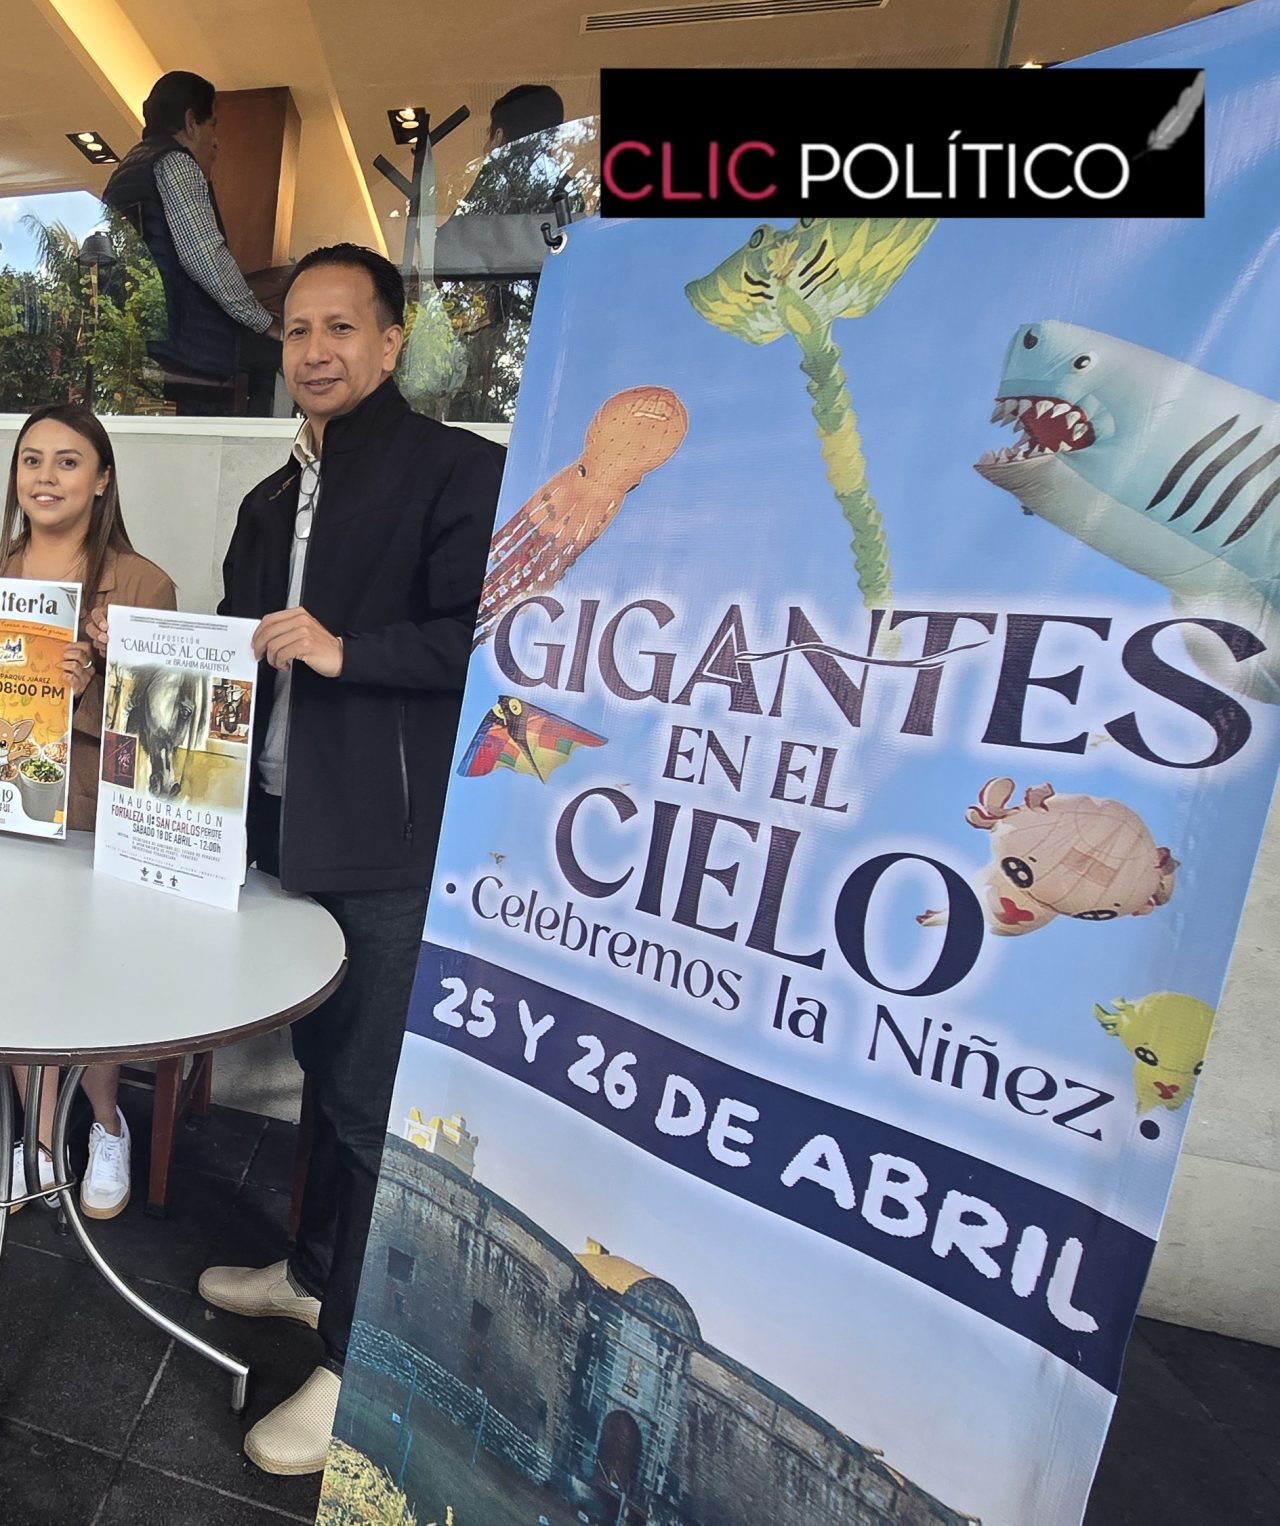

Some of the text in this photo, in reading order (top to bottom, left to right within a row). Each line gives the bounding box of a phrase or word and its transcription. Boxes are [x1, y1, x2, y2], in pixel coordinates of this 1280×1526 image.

[179, 645, 194, 659] AL
[200, 661, 230, 673] BAUTISTA
[40, 685, 65, 700] PM
[494, 594, 1269, 770] GIGANTES
[662, 724, 850, 814] EN EL
[2, 789, 14, 803] 19
[113, 791, 223, 828] INAUGURACIÓN
[111, 804, 145, 824] FORTALEZA
[156, 816, 171, 831] SAN
[171, 820, 201, 837] CARLOS
[200, 826, 222, 839] PEROTE
[132, 822, 155, 838] SÁBADO
[164, 832, 173, 843] DE
[173, 834, 192, 847] ABRIL
[554, 786, 986, 998] CIELO
[470, 875, 1116, 1142] Celebremos la Niñez
[434, 976, 1100, 1335] 25 Y 26 DE ABRIL
